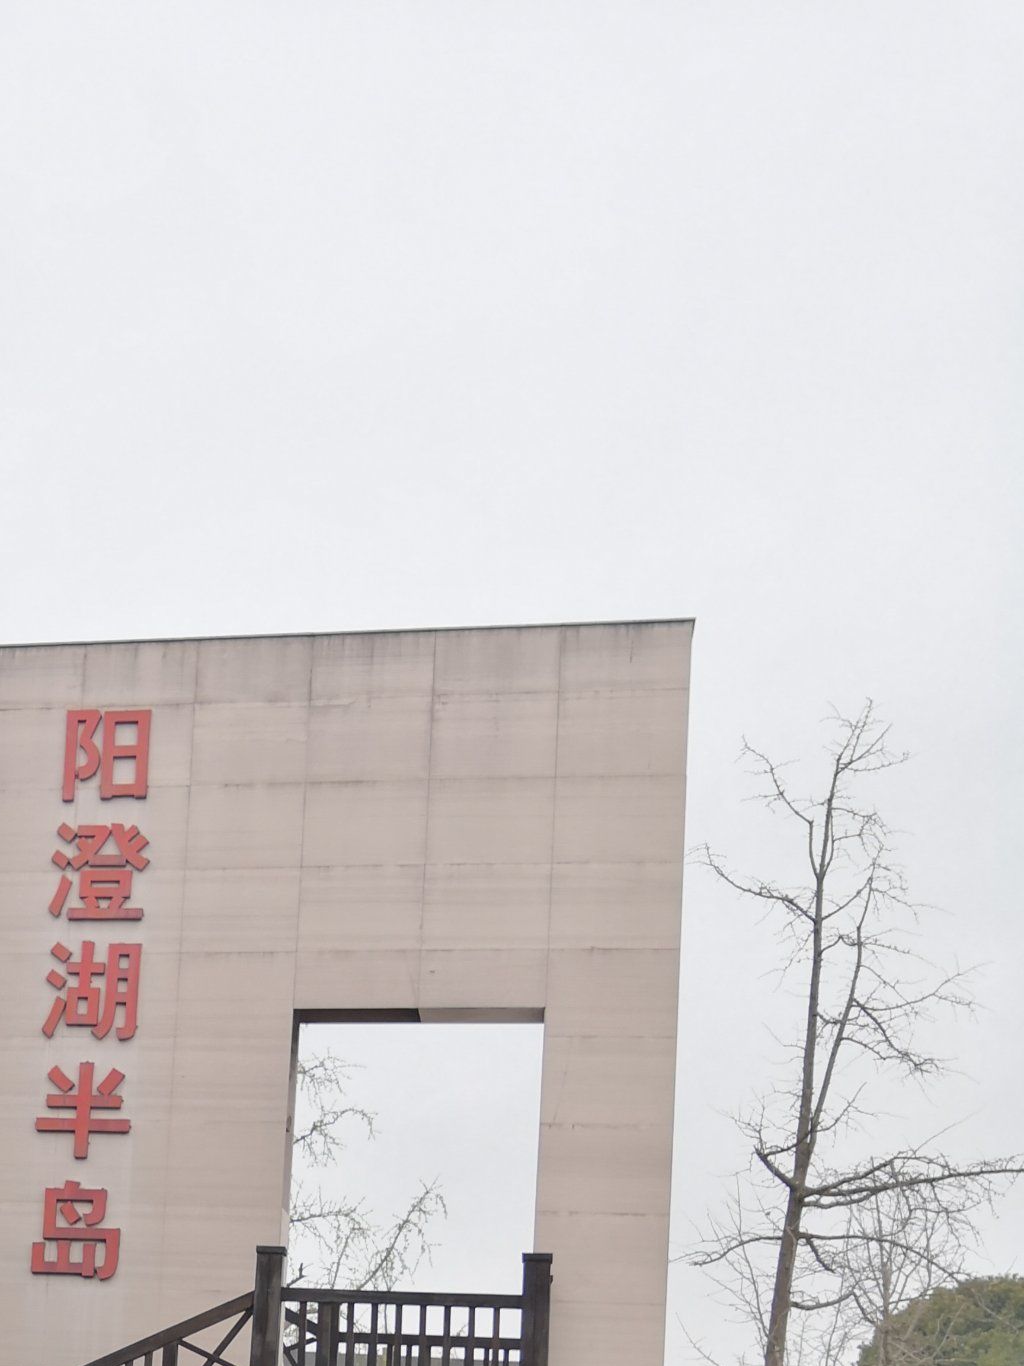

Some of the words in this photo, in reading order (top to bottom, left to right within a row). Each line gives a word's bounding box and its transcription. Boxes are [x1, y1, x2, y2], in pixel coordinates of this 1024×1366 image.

[31, 709, 152, 1281] 阳澄湖半岛
